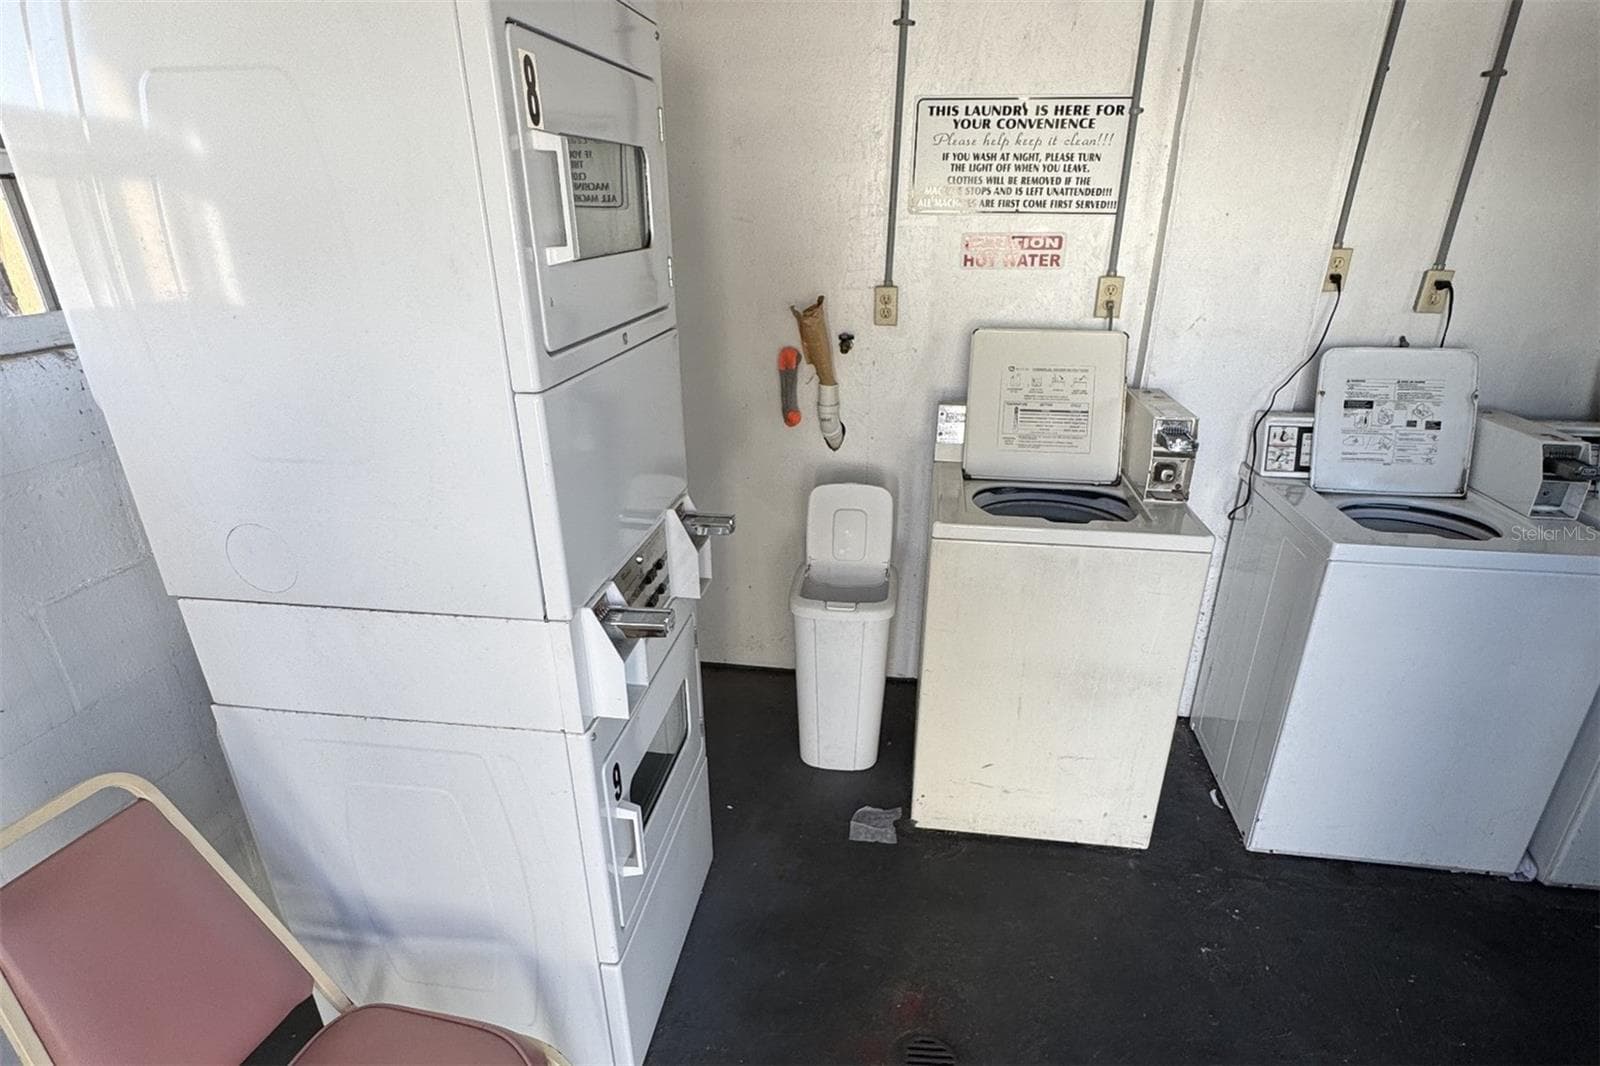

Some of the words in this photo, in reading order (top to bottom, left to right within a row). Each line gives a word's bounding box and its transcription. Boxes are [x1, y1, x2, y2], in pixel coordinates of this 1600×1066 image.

[523, 54, 540, 127] 8
[928, 105, 959, 116] THIS
[964, 105, 1028, 116] LAUNDRY
[1035, 105, 1048, 116] IS
[1054, 105, 1090, 116] HERE
[1096, 105, 1125, 116] FOR
[953, 119, 991, 129] YOUR
[996, 118, 1096, 129] CONVENIENCE
[933, 132, 976, 146] Please
[983, 132, 1010, 151] help
[1015, 132, 1042, 151] keep
[1048, 136, 1057, 146] it
[1064, 132, 1115, 146] clean!!!
[942, 153, 950, 161] IF
[953, 153, 970, 161] YOU
[973, 153, 997, 161] WASH
[1000, 153, 1010, 161] AT
[1013, 153, 1042, 162] NIGHT,
[1045, 153, 1075, 161] PLEASE
[1079, 153, 1102, 161] TURN
[951, 163, 965, 172] THE
[969, 163, 993, 172] LIGHT
[996, 163, 1011, 172] OFF
[1014, 164, 1039, 172] WHEN
[1042, 164, 1060, 172] YOU
[1063, 164, 1090, 172] LEAVE.
[947, 176, 983, 184] CLOTHES
[985, 176, 1004, 185] WILL
[1008, 176, 1018, 185] BE
[1020, 177, 1062, 185] REMOVED
[1064, 177, 1072, 185] IF
[1076, 177, 1091, 186] THE
[965, 187, 991, 195] STOPS
[993, 187, 1012, 195] AND
[1015, 187, 1023, 196] IS
[1026, 187, 1043, 196] LEFT
[1046, 187, 1112, 196] UNATTENDED!!!
[979, 199, 994, 208] ARE
[997, 200, 1020, 208] FIRST
[1022, 200, 1047, 209] COME
[1050, 200, 1073, 209] FIRST
[1075, 201, 1117, 209] SERVED!!!
[1003, 254, 1061, 267] WATER
[612, 762, 622, 801] 9
